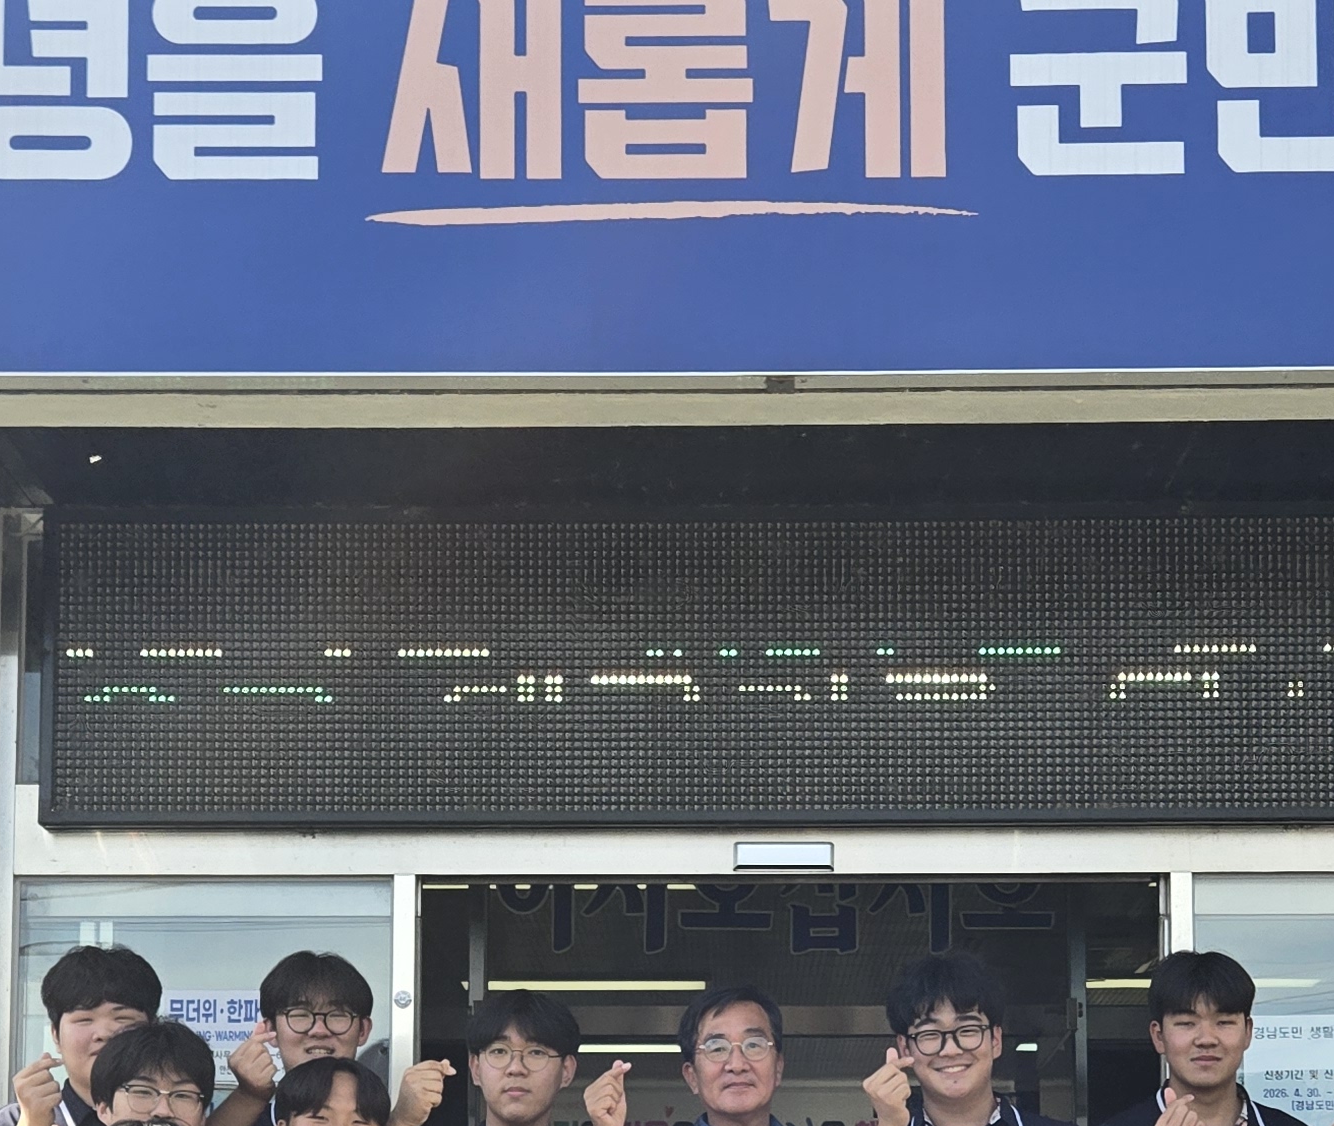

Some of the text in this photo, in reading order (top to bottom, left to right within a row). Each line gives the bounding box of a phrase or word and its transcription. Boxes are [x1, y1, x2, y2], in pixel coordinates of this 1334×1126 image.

[381, 0, 947, 181] 새롭게
[1254, 1026, 1303, 1040] 경남도민
[1264, 1070, 1304, 1080] 신청기간
[1263, 1088, 1290, 1098] 2026.
[1294, 1088, 1303, 1097] 4.
[1307, 1088, 1321, 1098] 30.
